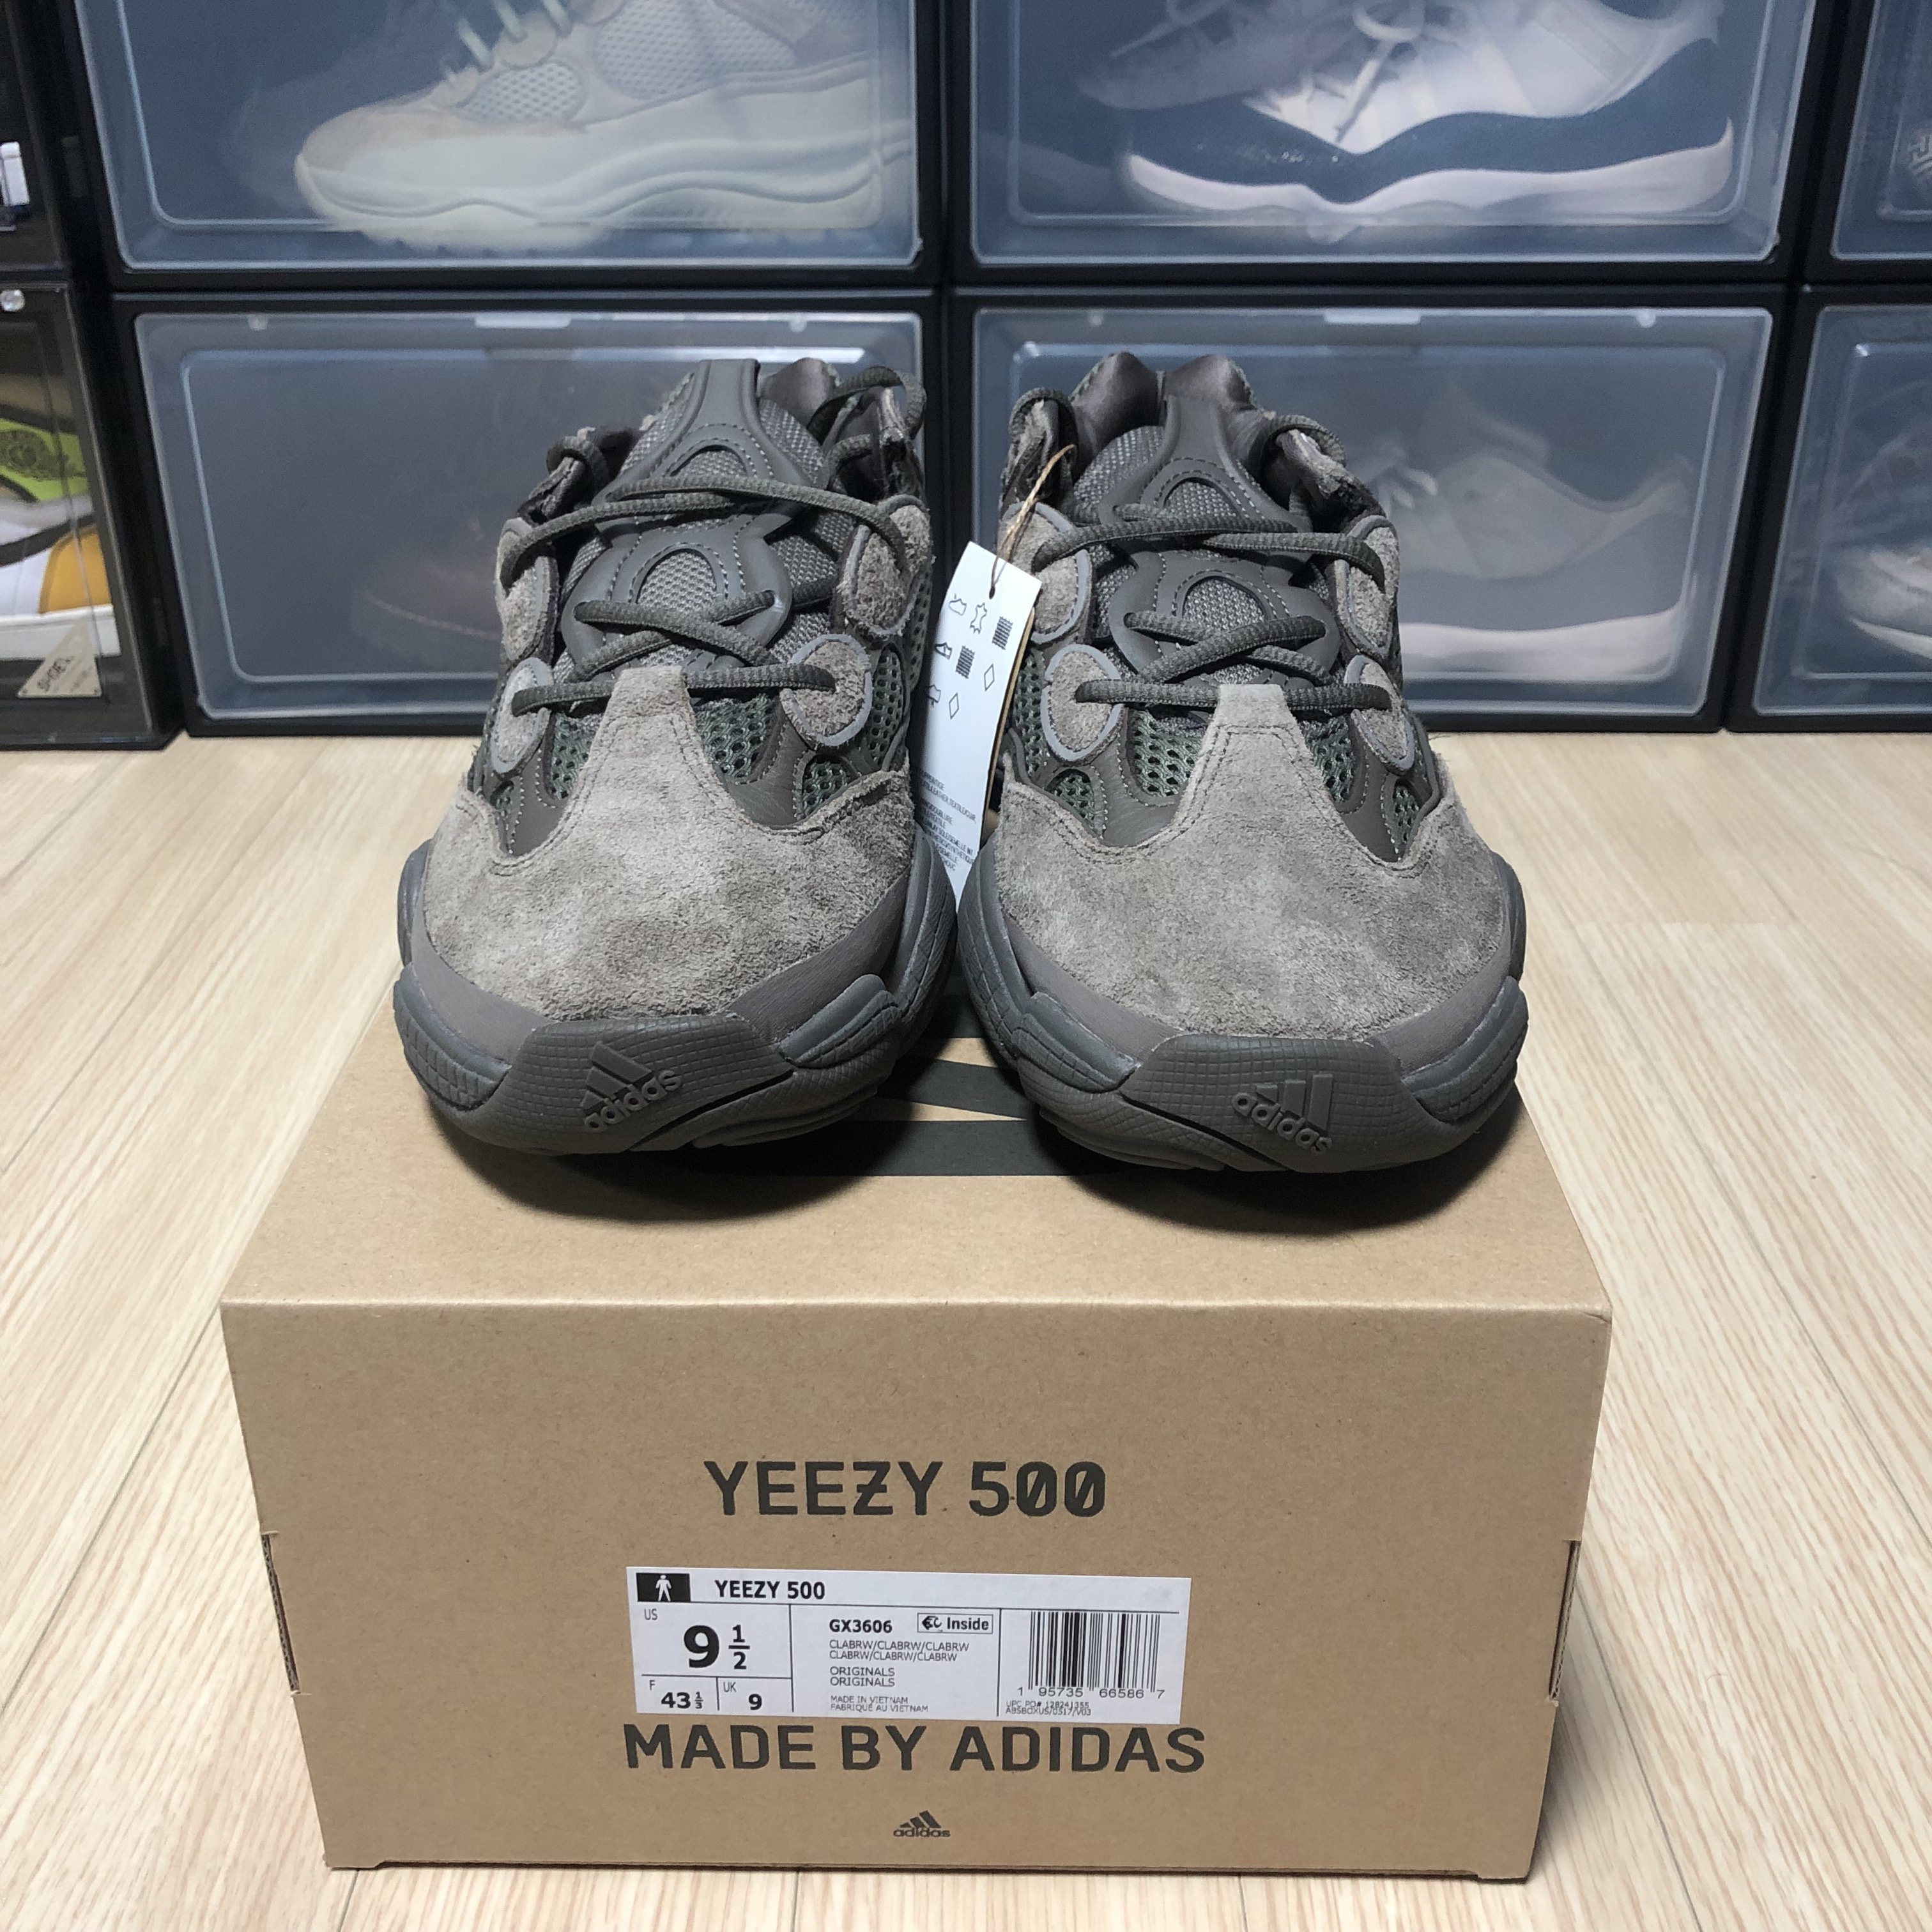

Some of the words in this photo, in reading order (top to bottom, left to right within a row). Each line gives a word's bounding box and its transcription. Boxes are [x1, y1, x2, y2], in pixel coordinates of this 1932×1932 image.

[585, 1070, 682, 1133] adidas
[1231, 1092, 1333, 1155] adidas
[704, 1461, 943, 1515] YEEZY
[969, 1461, 1105, 1517] 500
[715, 1580, 780, 1598] YEEZY
[787, 1581, 825, 1600] 500
[644, 1608, 658, 1621] US
[829, 1618, 893, 1634] GX3606
[947, 1616, 989, 1630] Inside
[684, 1625, 719, 1668] 9
[829, 1639, 969, 1652] CLABRW/CLABRW/CLABRW
[829, 1650, 957, 1662] CLABRW/CLABRW/CLABRW
[829, 1666, 895, 1676] ORIGINALS
[649, 1680, 656, 1690] F
[723, 1682, 737, 1692] UK
[829, 1676, 895, 1687] ORIGINALS
[1018, 1687, 1023, 1696] 1
[1038, 1687, 1084, 1698] 95735
[1099, 1689, 1144, 1698] 66586
[1156, 1690, 1165, 1699] 7
[661, 1692, 691, 1708] 43
[748, 1694, 762, 1710] 9
[869, 1696, 908, 1705] VIETNAM
[831, 1703, 873, 1712] FABRIQUE
[623, 1724, 816, 1770] MADE
[841, 1726, 926, 1771] BY
[949, 1726, 1205, 1774] ADIDAS
[893, 1827, 951, 1837] adidas
